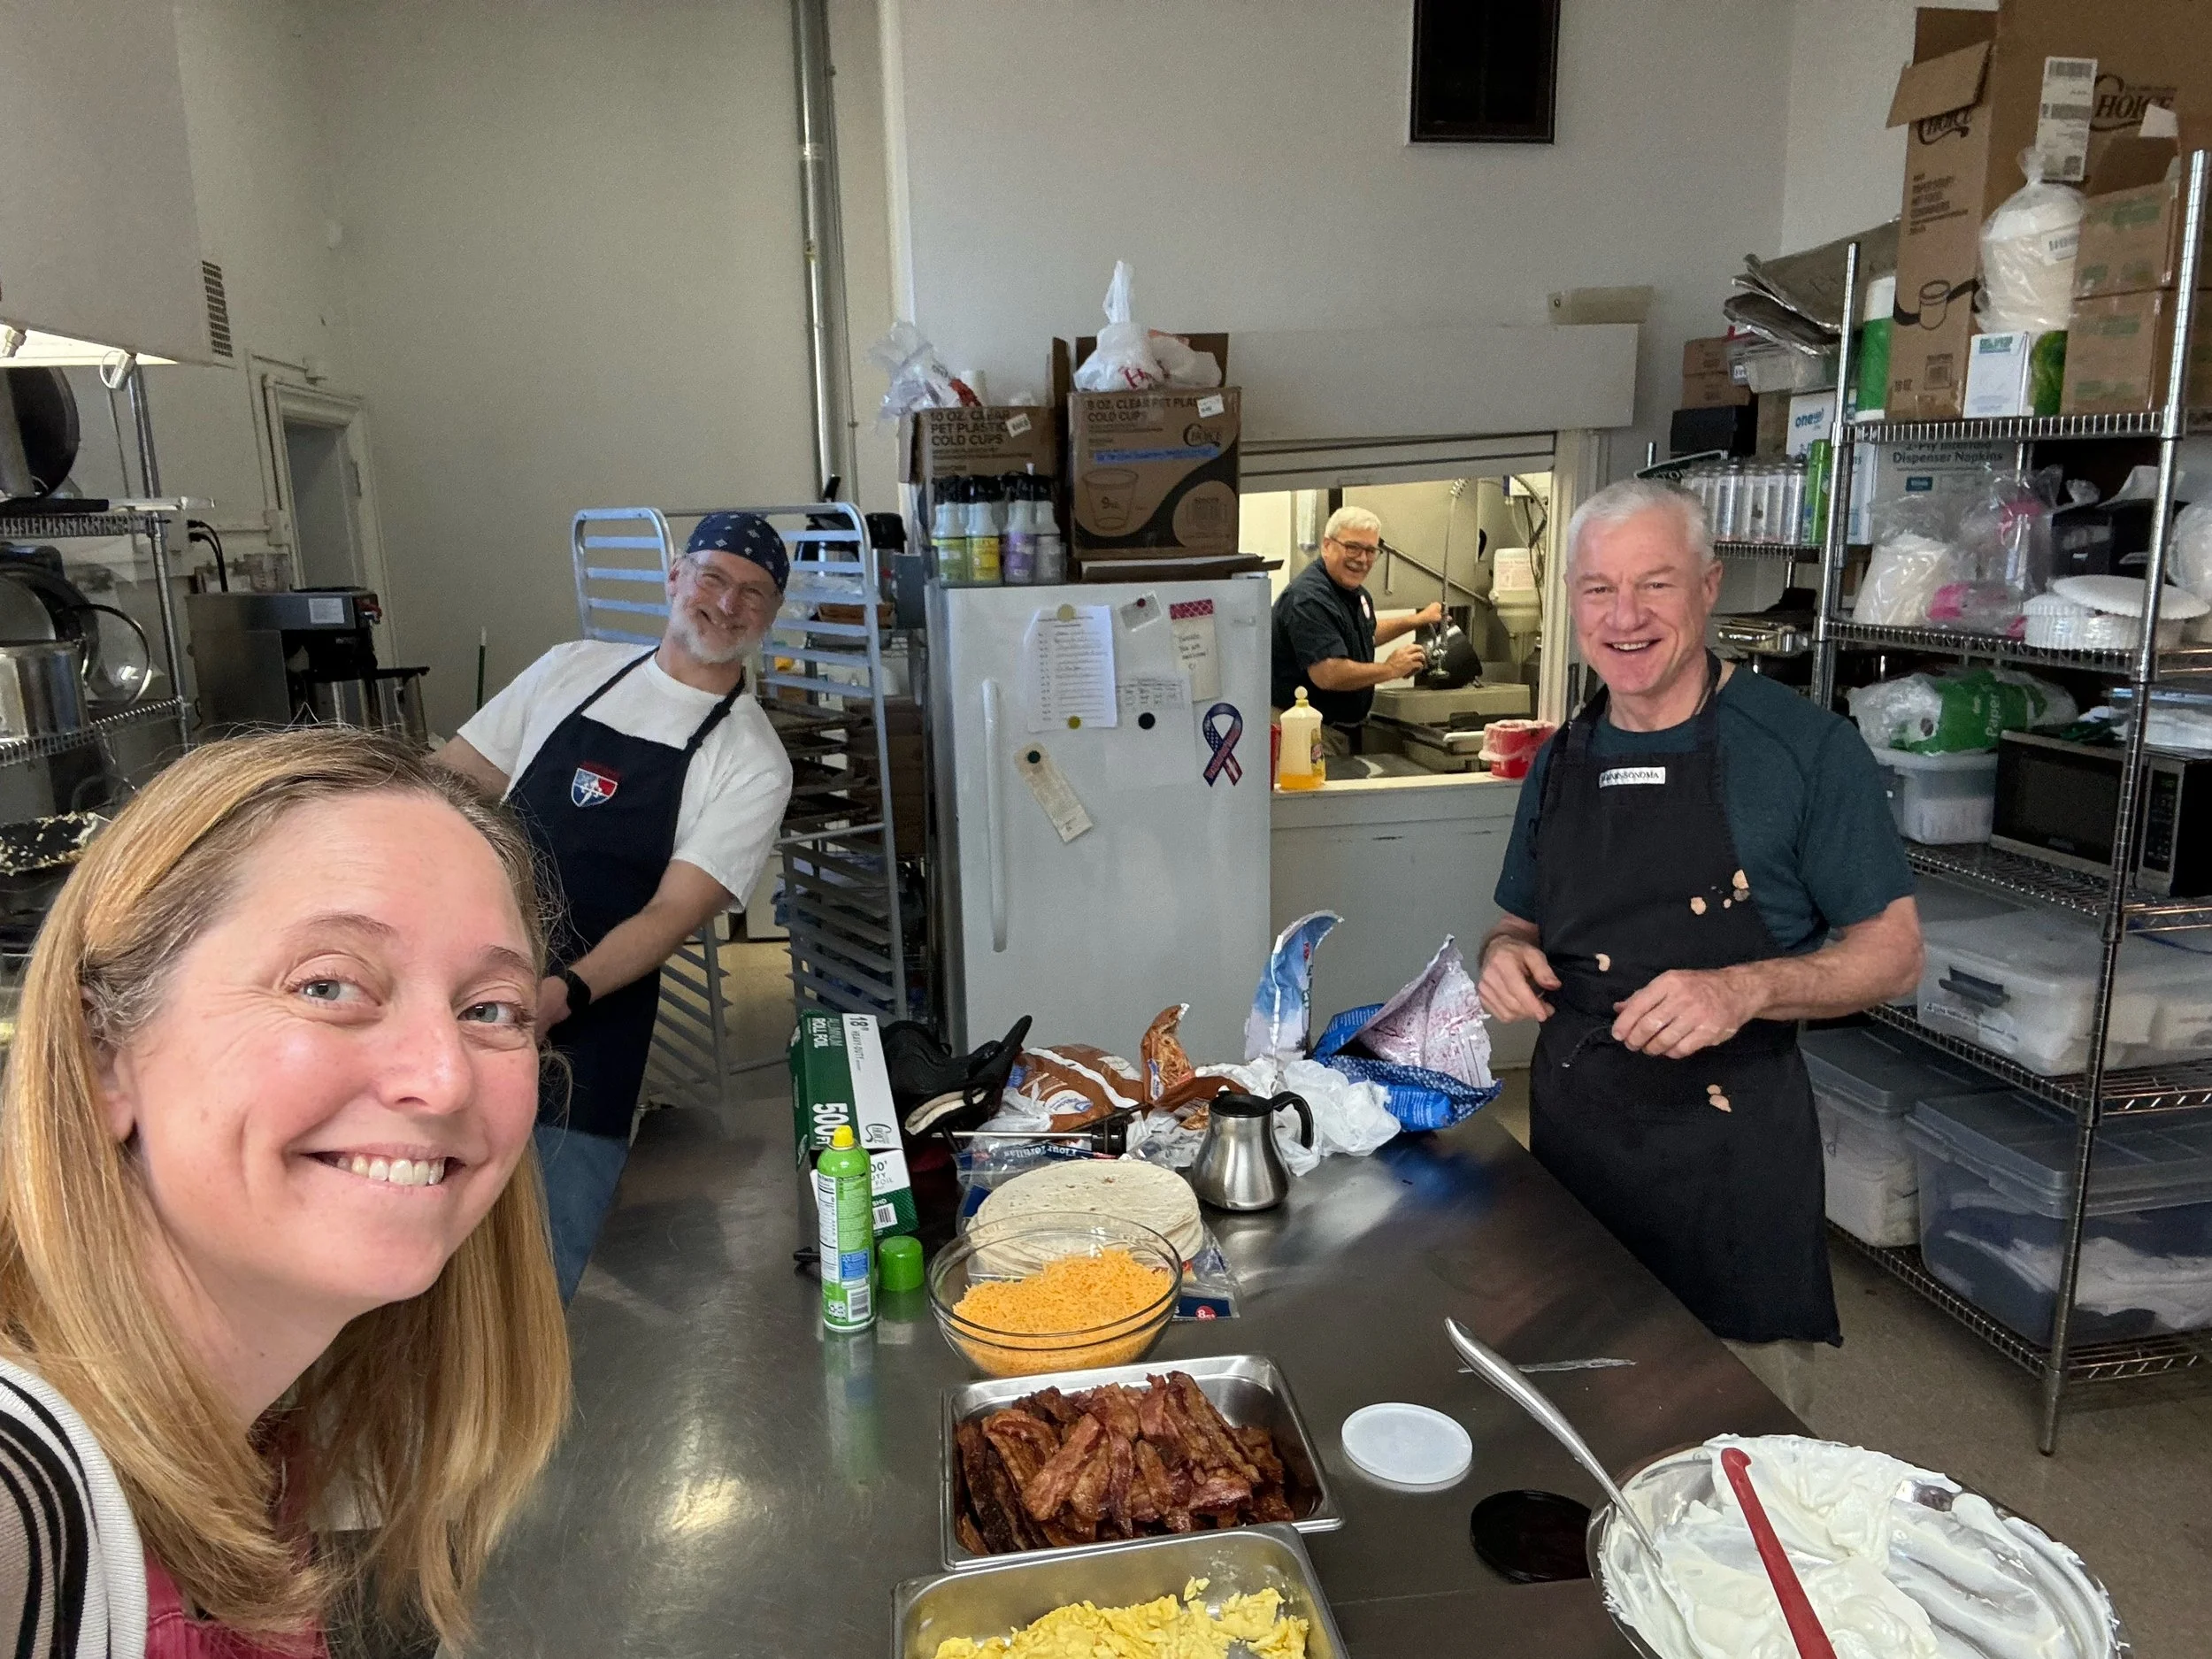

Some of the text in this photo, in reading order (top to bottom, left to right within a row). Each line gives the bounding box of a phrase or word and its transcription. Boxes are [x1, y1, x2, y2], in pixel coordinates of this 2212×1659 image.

[970, 410, 1010, 421] CLEAR
[1087, 411, 1117, 423] COLD
[932, 423, 953, 434] PET
[932, 434, 1003, 446] COLD CUPS
[1892, 450, 2003, 465] Dispenser Napkins
[1984, 694, 2001, 737] Paper
[811, 1018, 829, 1048] ROLL FOIL
[865, 1123, 892, 1144] CHOICE
[1002, 1145, 1078, 1158] Flour Tortillas
[875, 1178, 895, 1187] FOIL
